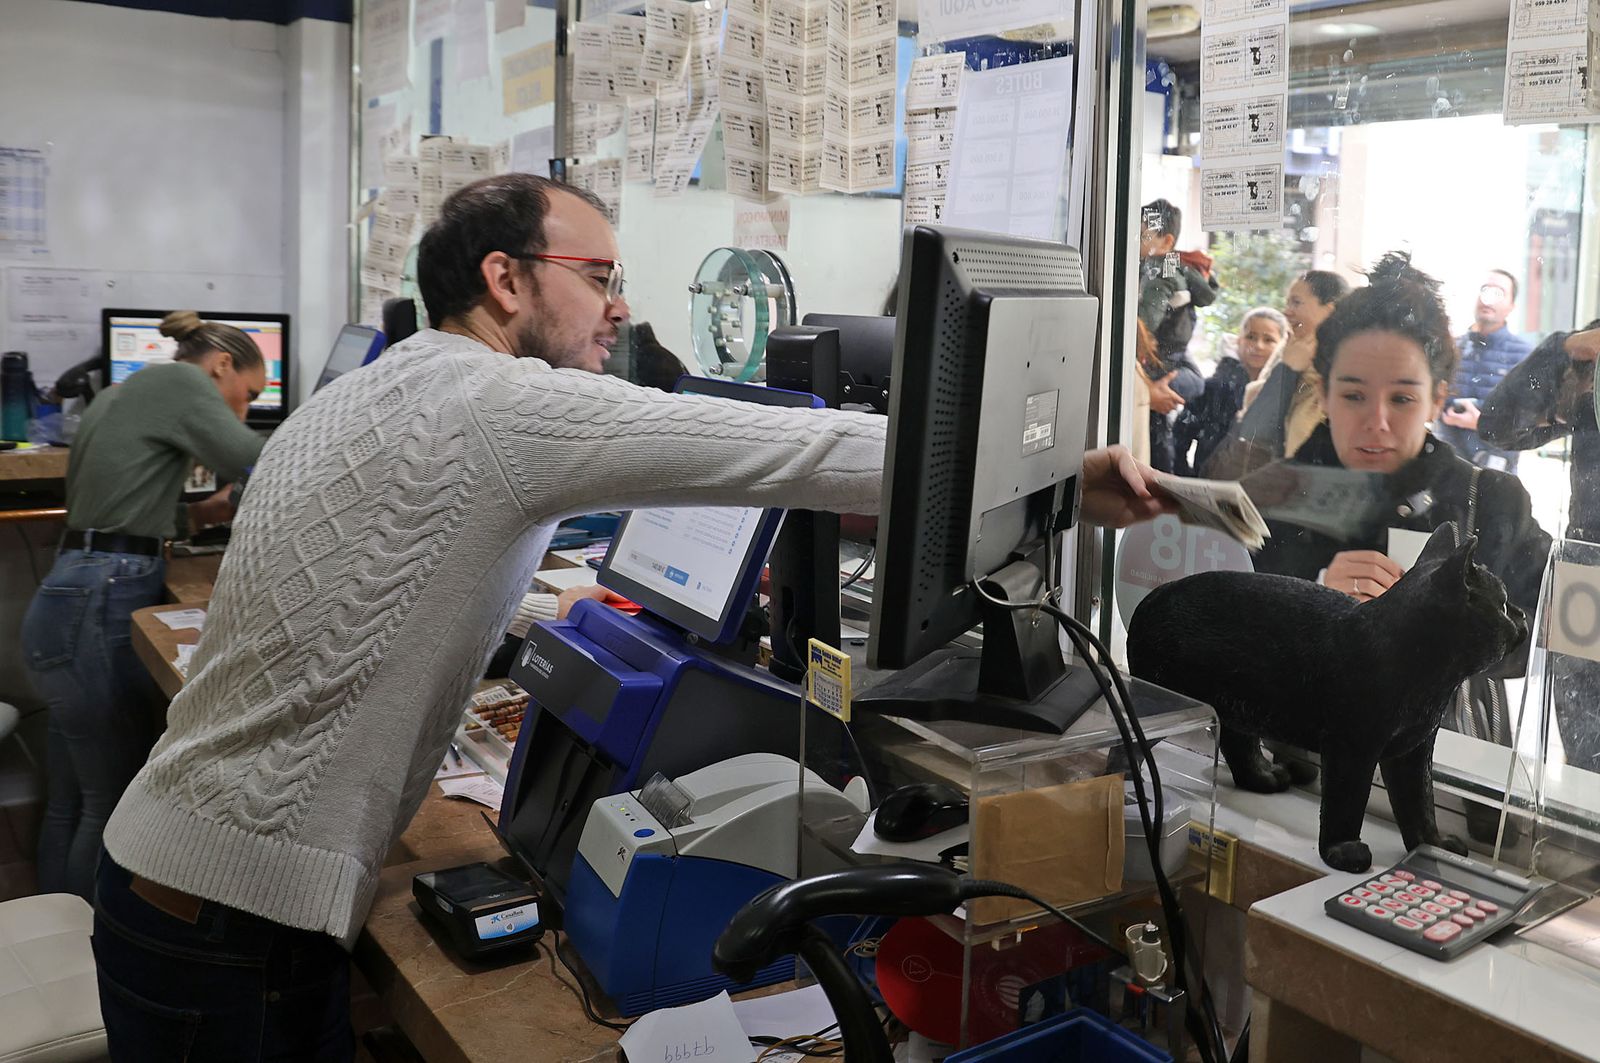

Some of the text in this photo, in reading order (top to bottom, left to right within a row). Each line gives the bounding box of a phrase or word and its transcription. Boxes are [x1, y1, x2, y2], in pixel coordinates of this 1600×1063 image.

[1270, 54, 1276, 64] 2
[1268, 121, 1274, 131] 2
[1267, 189, 1273, 199] 2
[531, 652, 554, 674] LOTERÍAS
